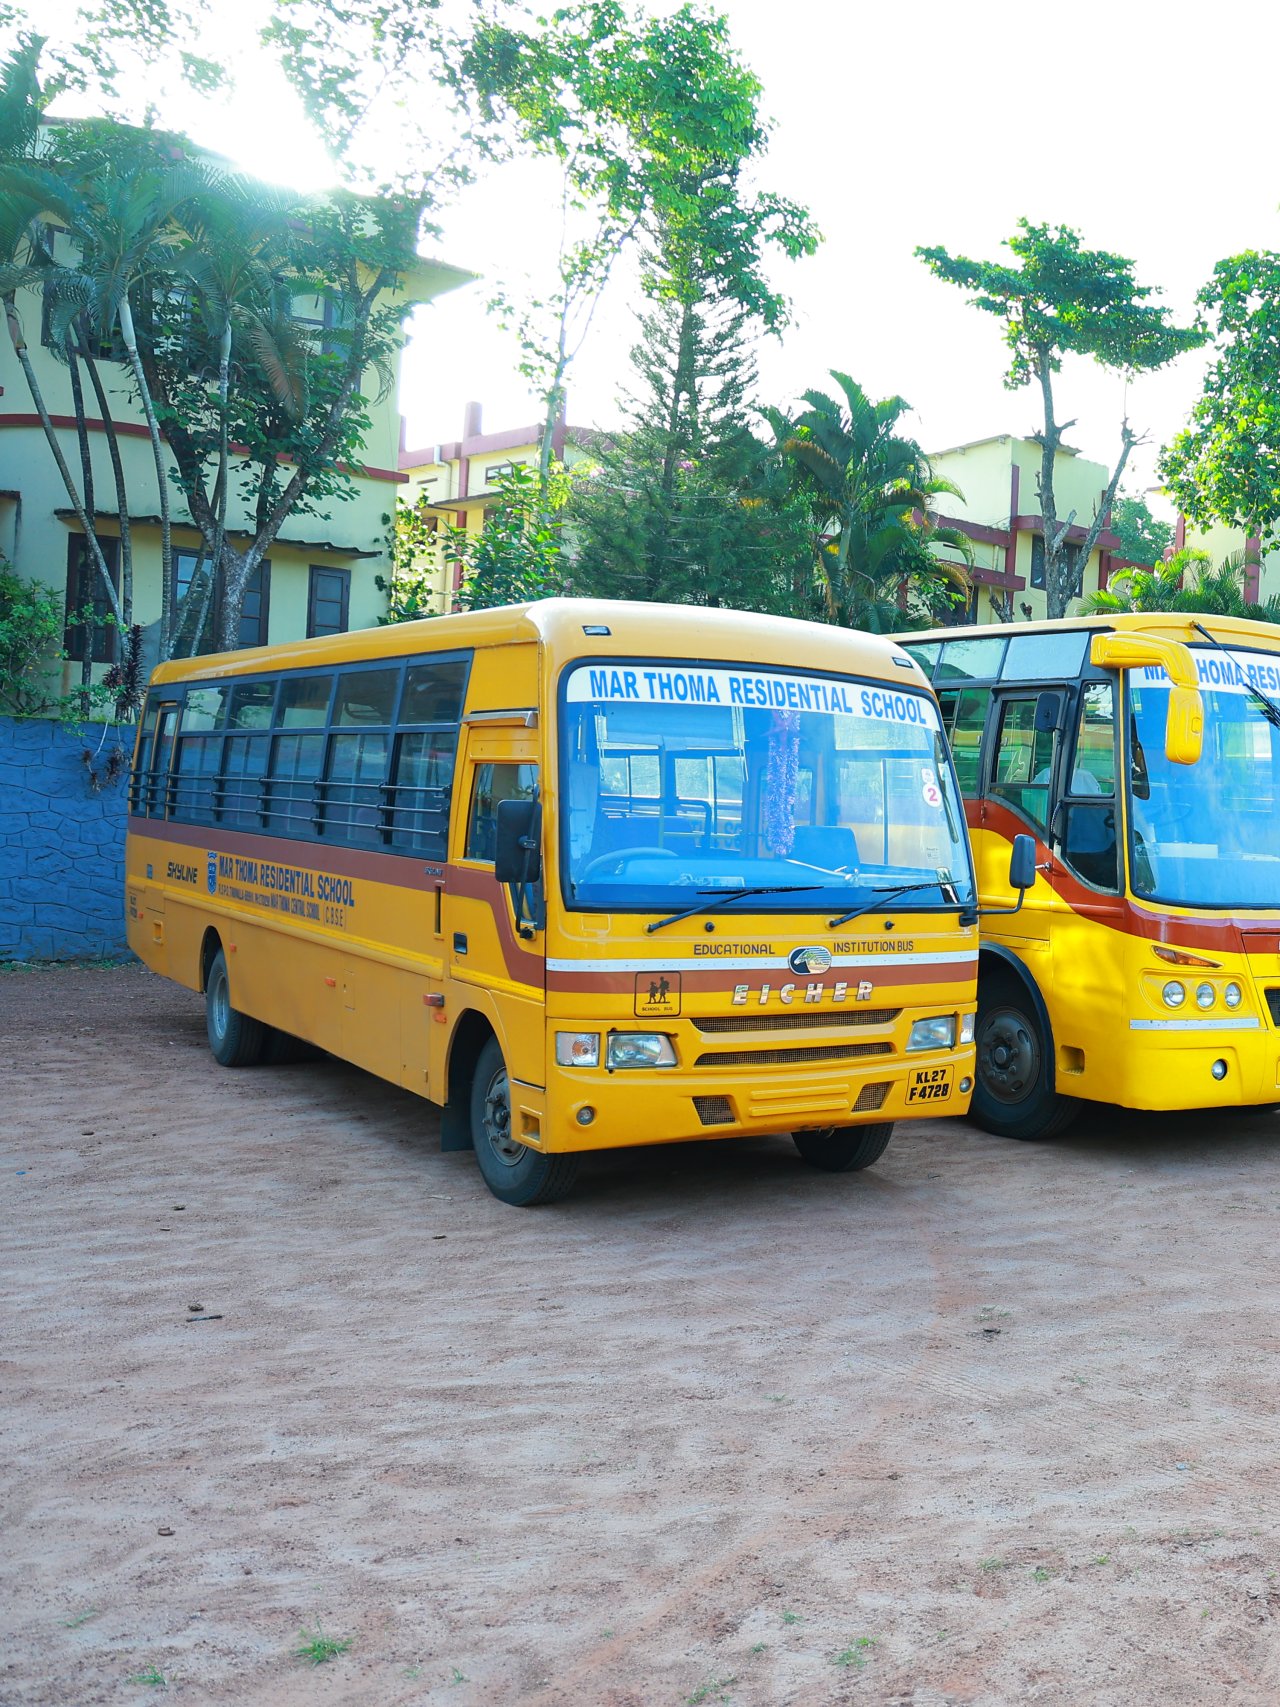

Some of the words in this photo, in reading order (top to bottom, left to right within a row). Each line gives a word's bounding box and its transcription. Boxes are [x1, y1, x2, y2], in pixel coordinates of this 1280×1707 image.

[1144, 665, 1170, 680] MA
[1196, 658, 1245, 686] HOMA
[589, 669, 640, 699] MAR
[643, 671, 721, 703] THOMA
[729, 677, 853, 714] RESIDENTIAL
[861, 691, 927, 725] SCHOOL
[927, 787, 938, 802] 2
[167, 861, 198, 884] SKYLINE
[219, 856, 233, 879] MAR
[235, 859, 258, 884] THOMA
[260, 864, 315, 898] RESIDENTIAL
[317, 876, 355, 907] SCHOOL
[693, 943, 775, 956] EDUCATIONAL
[833, 940, 895, 954] INSTITUTION
[897, 939, 914, 952] BUS
[732, 979, 874, 1006] EICHER
[915, 1069, 947, 1084] KL27
